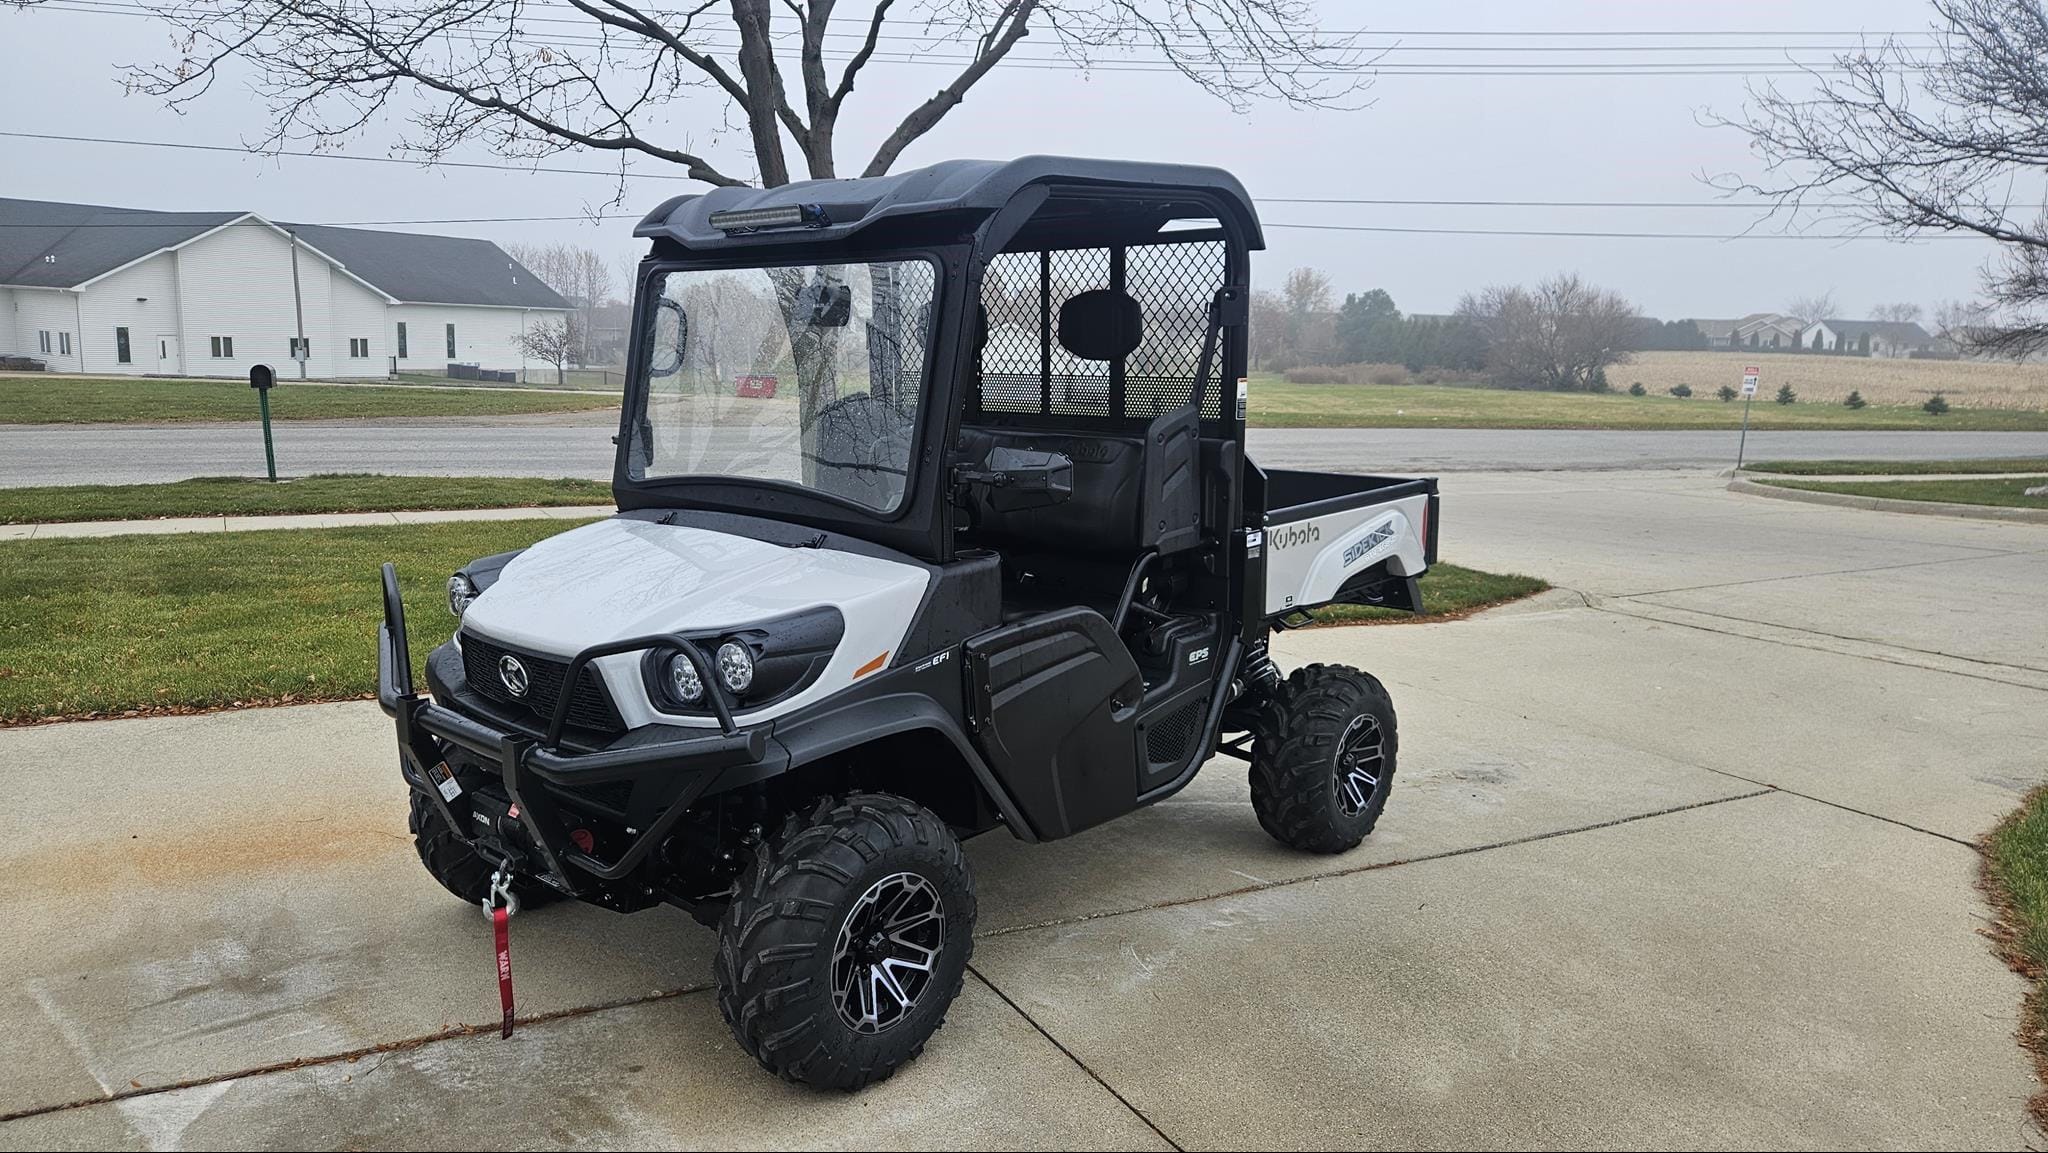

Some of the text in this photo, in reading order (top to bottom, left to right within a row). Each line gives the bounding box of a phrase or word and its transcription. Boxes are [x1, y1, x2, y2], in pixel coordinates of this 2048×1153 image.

[1268, 522, 1320, 551] Kubota
[932, 651, 950, 666] EFI
[1188, 647, 1209, 662] EPS
[472, 810, 490, 826] AXON
[498, 949, 511, 981] WARN
